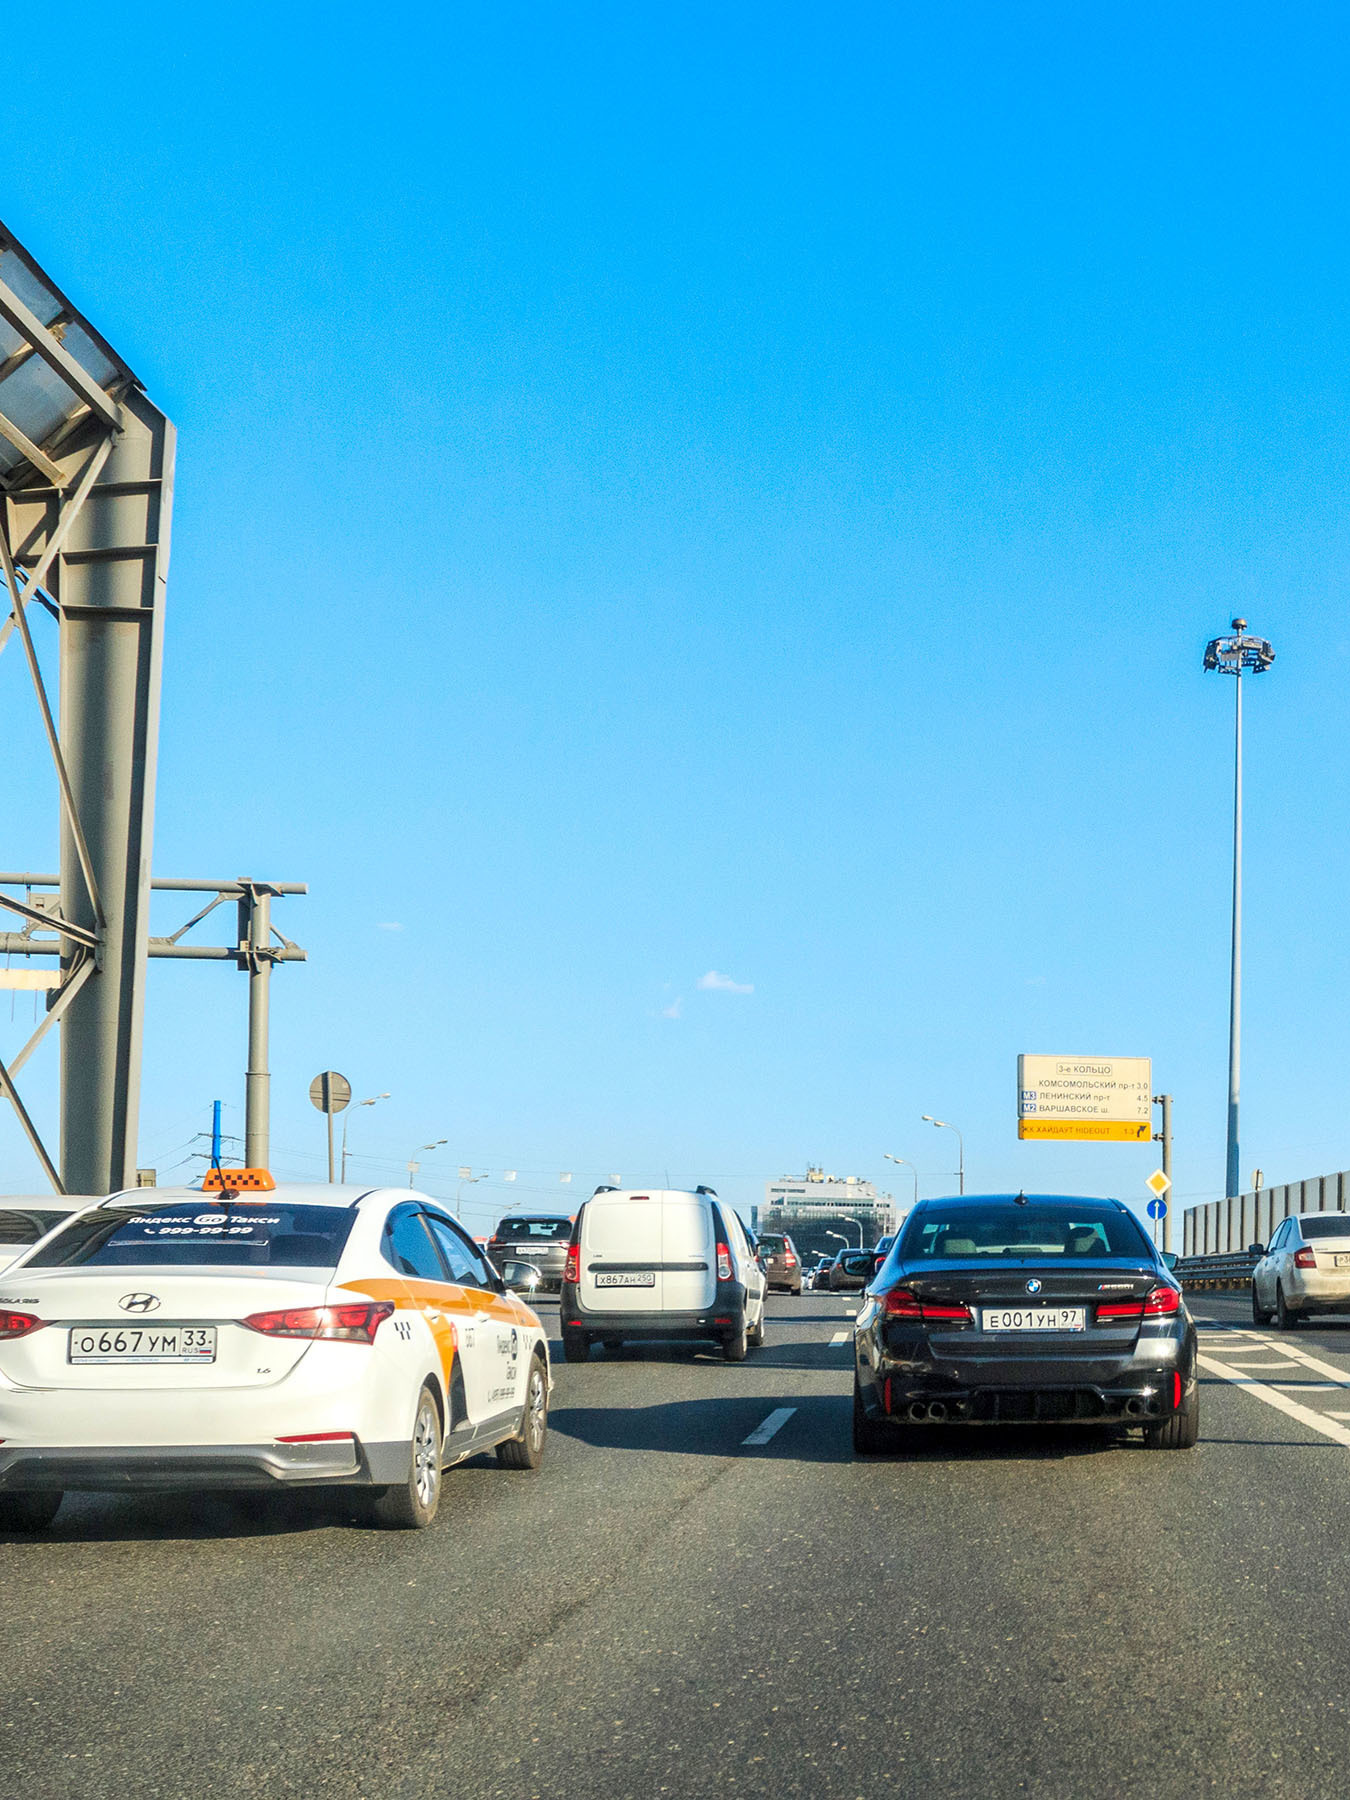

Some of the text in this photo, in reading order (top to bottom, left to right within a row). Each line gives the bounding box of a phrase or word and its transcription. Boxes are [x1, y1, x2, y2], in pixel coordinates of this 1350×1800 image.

[1073, 1065, 1111, 1075] КОЛЬЦО
[1038, 1079, 1117, 1088] КОМСОМОЛЬСКИЙ
[1039, 1091, 1092, 1100] ЛЕНИНСКИЙ
[1039, 1104, 1099, 1113] ВАРШАВСКОЕ
[1075, 1127, 1110, 1135] HIDEOUT
[127, 1215, 192, 1224] Яндекс
[229, 1215, 280, 1224] Такси
[158, 1226, 253, 1235] 999-99-99
[1061, 1310, 1076, 1322] 97
[183, 1330, 207, 1346] 33
